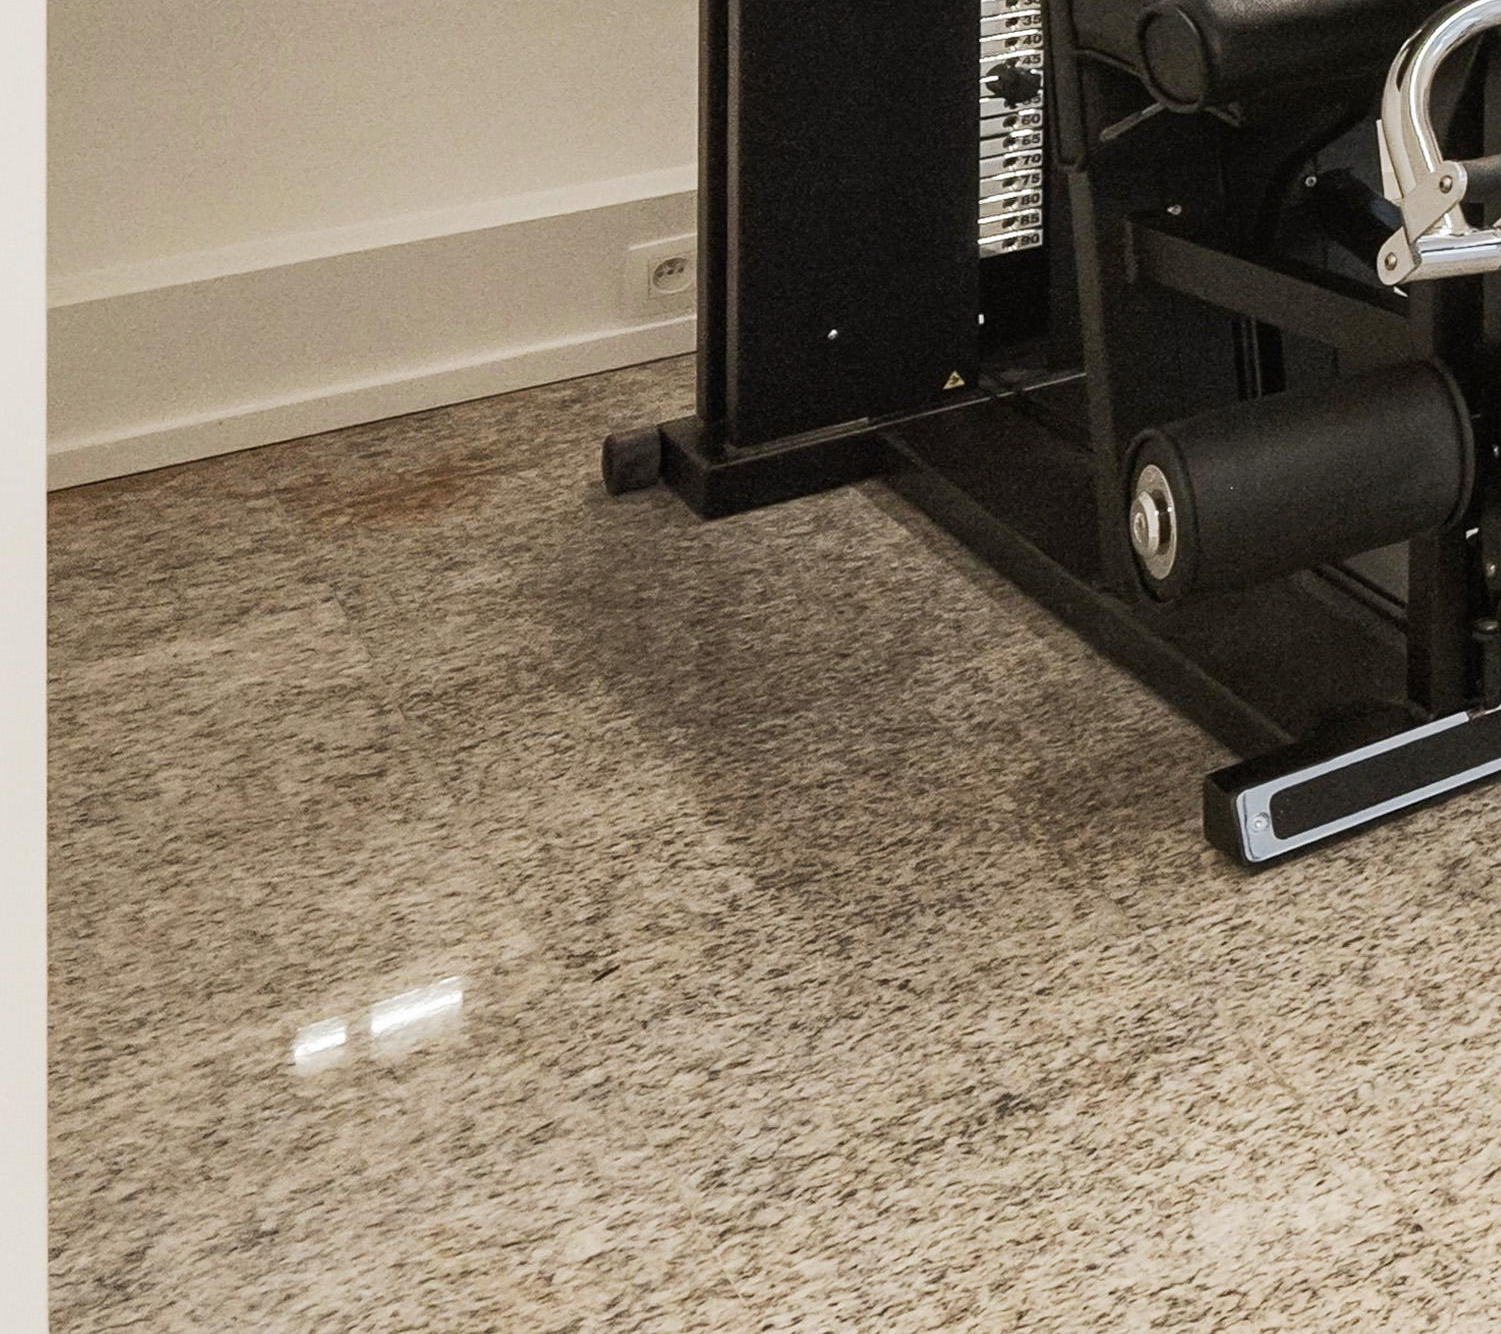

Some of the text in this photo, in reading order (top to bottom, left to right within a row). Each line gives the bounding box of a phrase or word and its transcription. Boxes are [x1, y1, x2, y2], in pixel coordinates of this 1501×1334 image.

[1023, 15, 1041, 26] 35
[1022, 34, 1042, 45] 40
[1022, 54, 1041, 65] 45
[1021, 114, 1041, 125] 60
[1021, 134, 1041, 146] 65
[1022, 154, 1041, 165] 70
[1021, 174, 1040, 186] 75
[1020, 193, 1040, 205] 80
[1020, 213, 1040, 225] 85
[1020, 234, 1040, 245] 90
